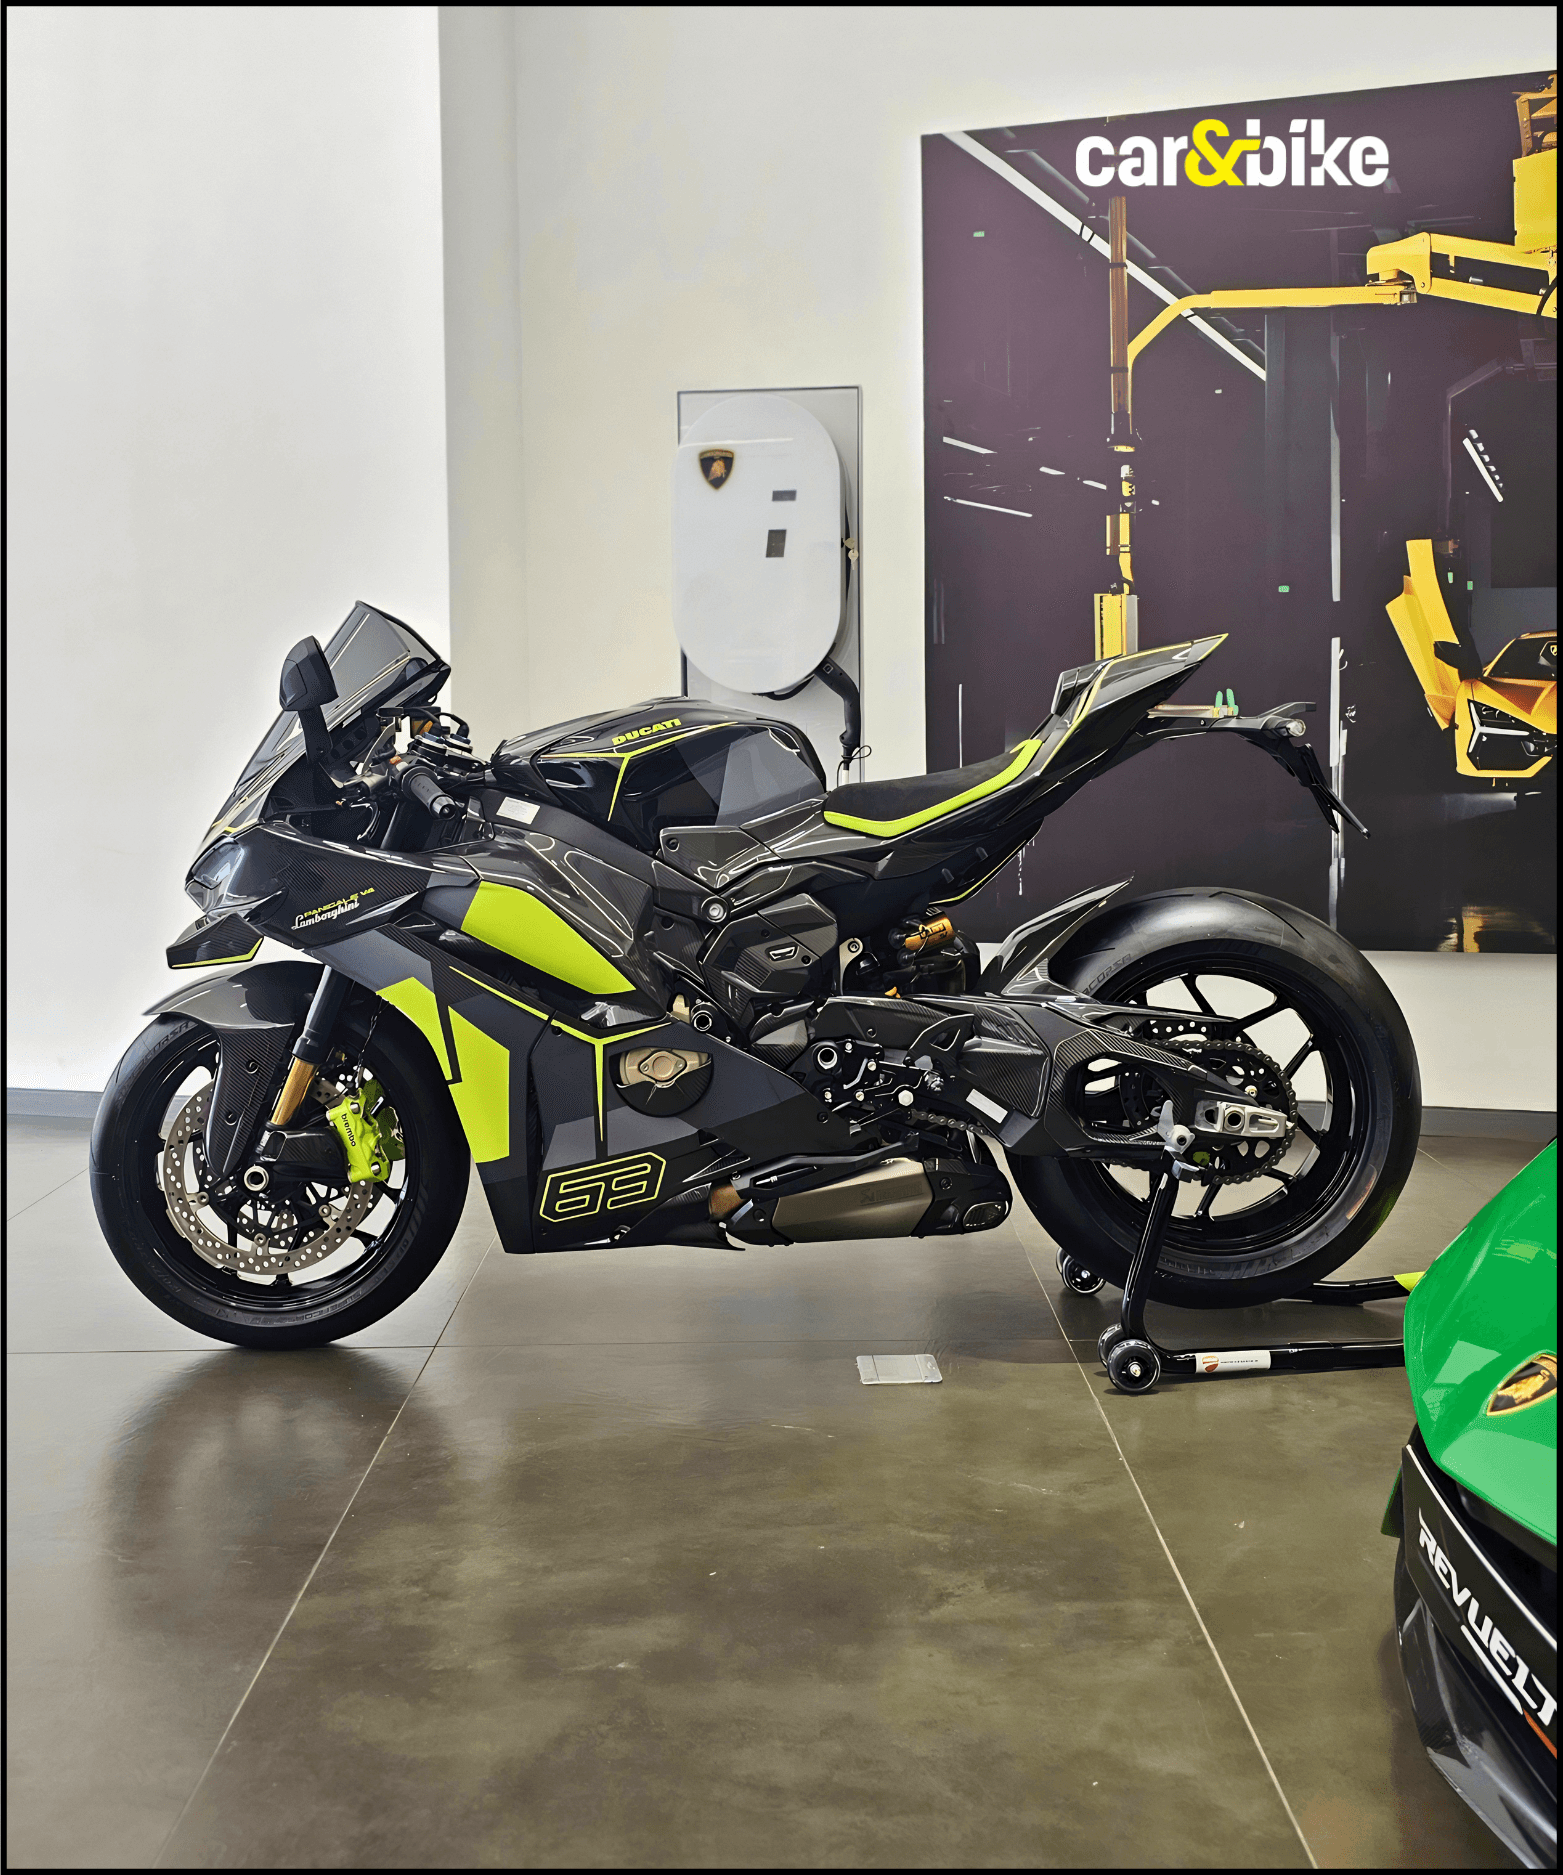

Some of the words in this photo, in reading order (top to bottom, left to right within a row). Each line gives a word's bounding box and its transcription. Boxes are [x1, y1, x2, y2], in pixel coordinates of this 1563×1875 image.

[611, 718, 682, 746] DUCATI
[291, 899, 360, 931] Lamborghini
[341, 1112, 356, 1147] brembo
[539, 1151, 667, 1223] 63
